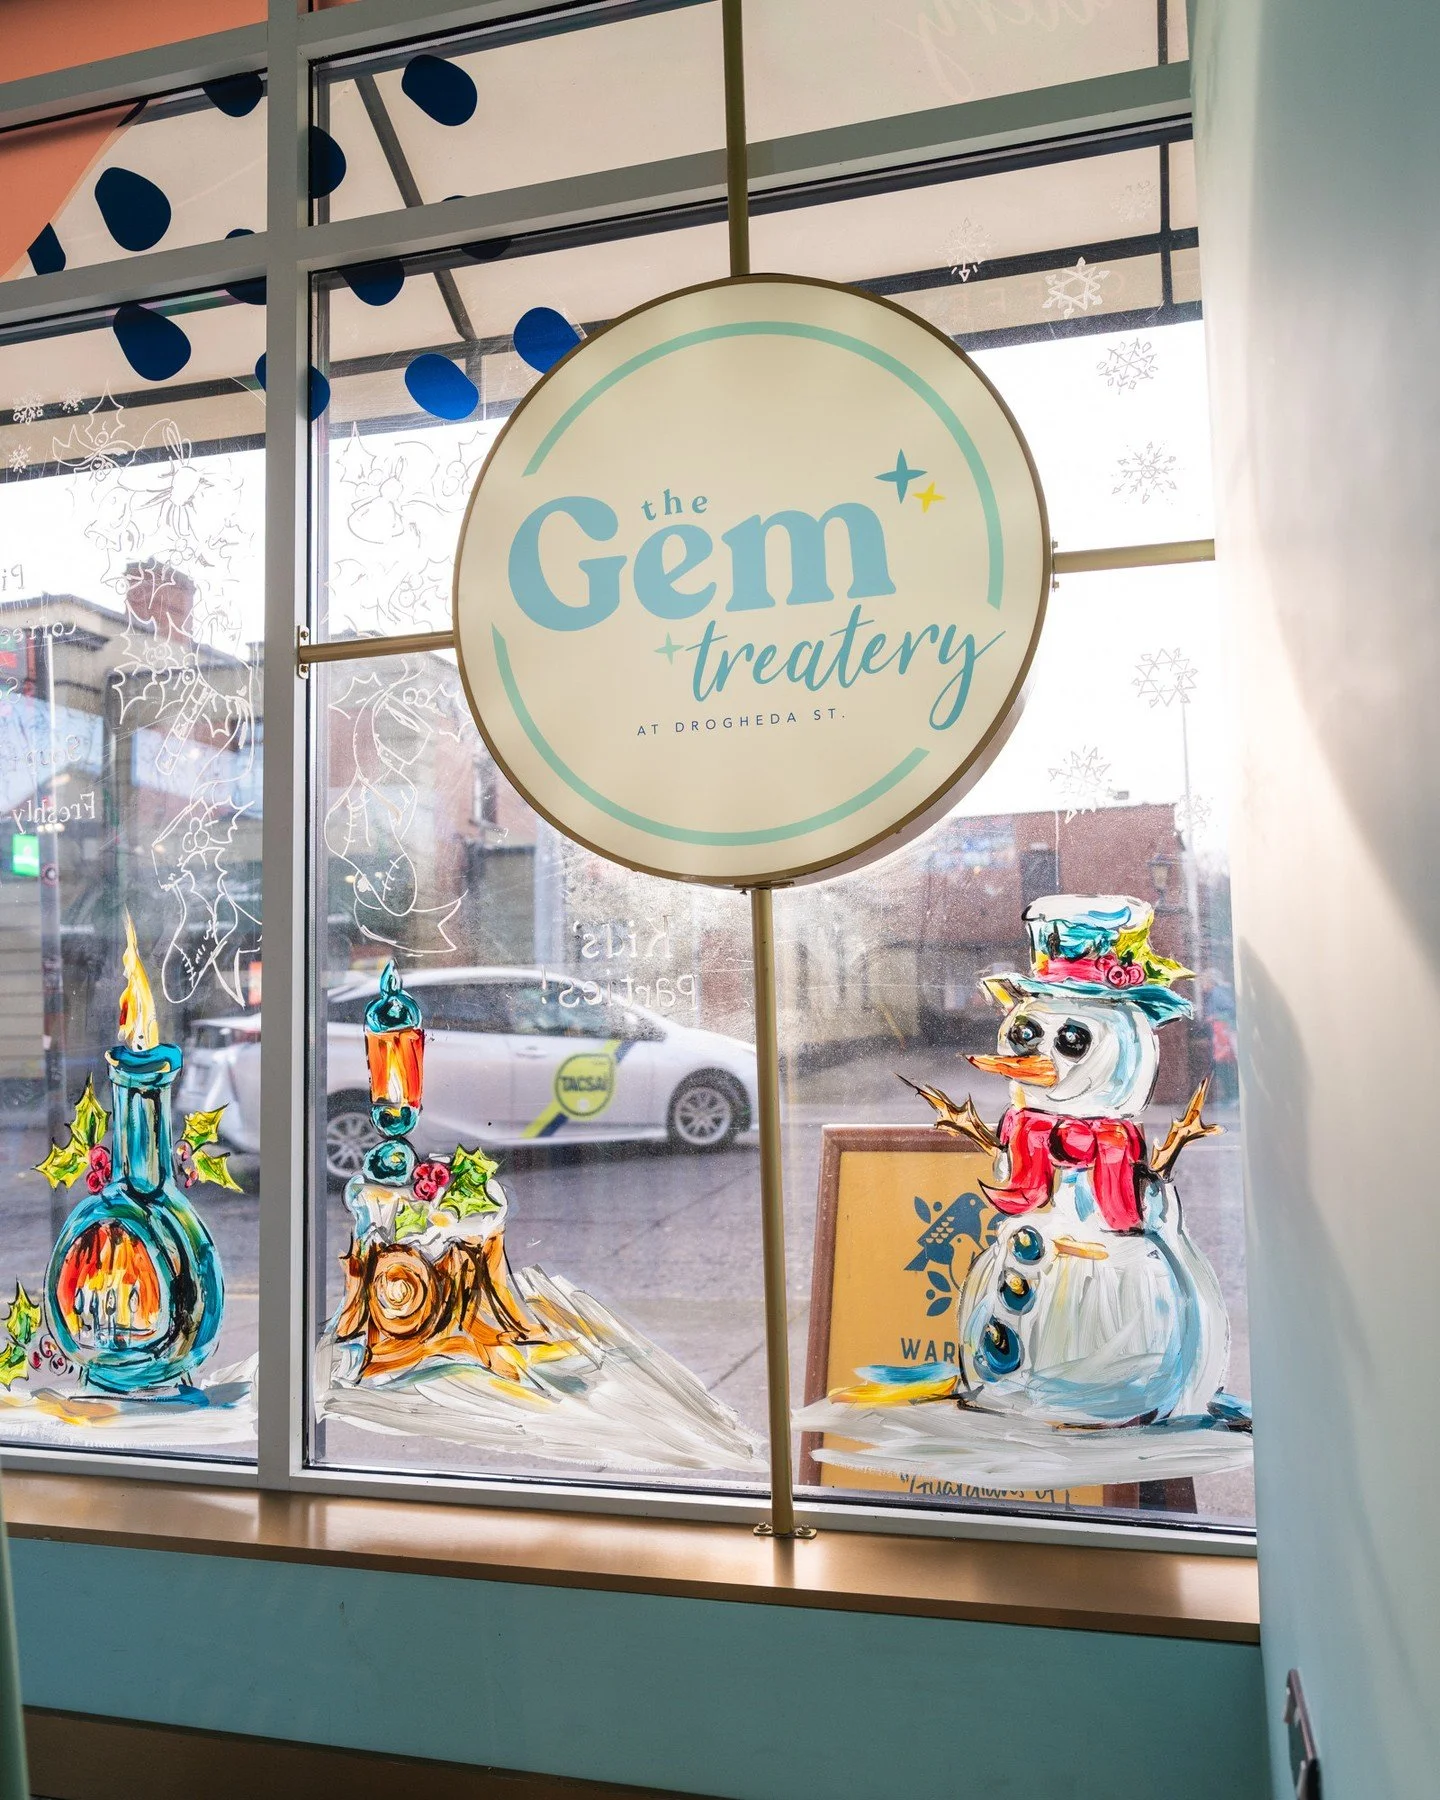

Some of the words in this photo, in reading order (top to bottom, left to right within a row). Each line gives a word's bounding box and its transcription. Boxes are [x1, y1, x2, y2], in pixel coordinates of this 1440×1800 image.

[641, 488, 708, 521] the
[508, 495, 896, 632] Gem
[685, 604, 1007, 731] treatery
[637, 723, 660, 736] AT
[675, 710, 798, 733] DROGHEDA
[813, 707, 846, 722] ST.
[901, 1338, 957, 1363] WAR
